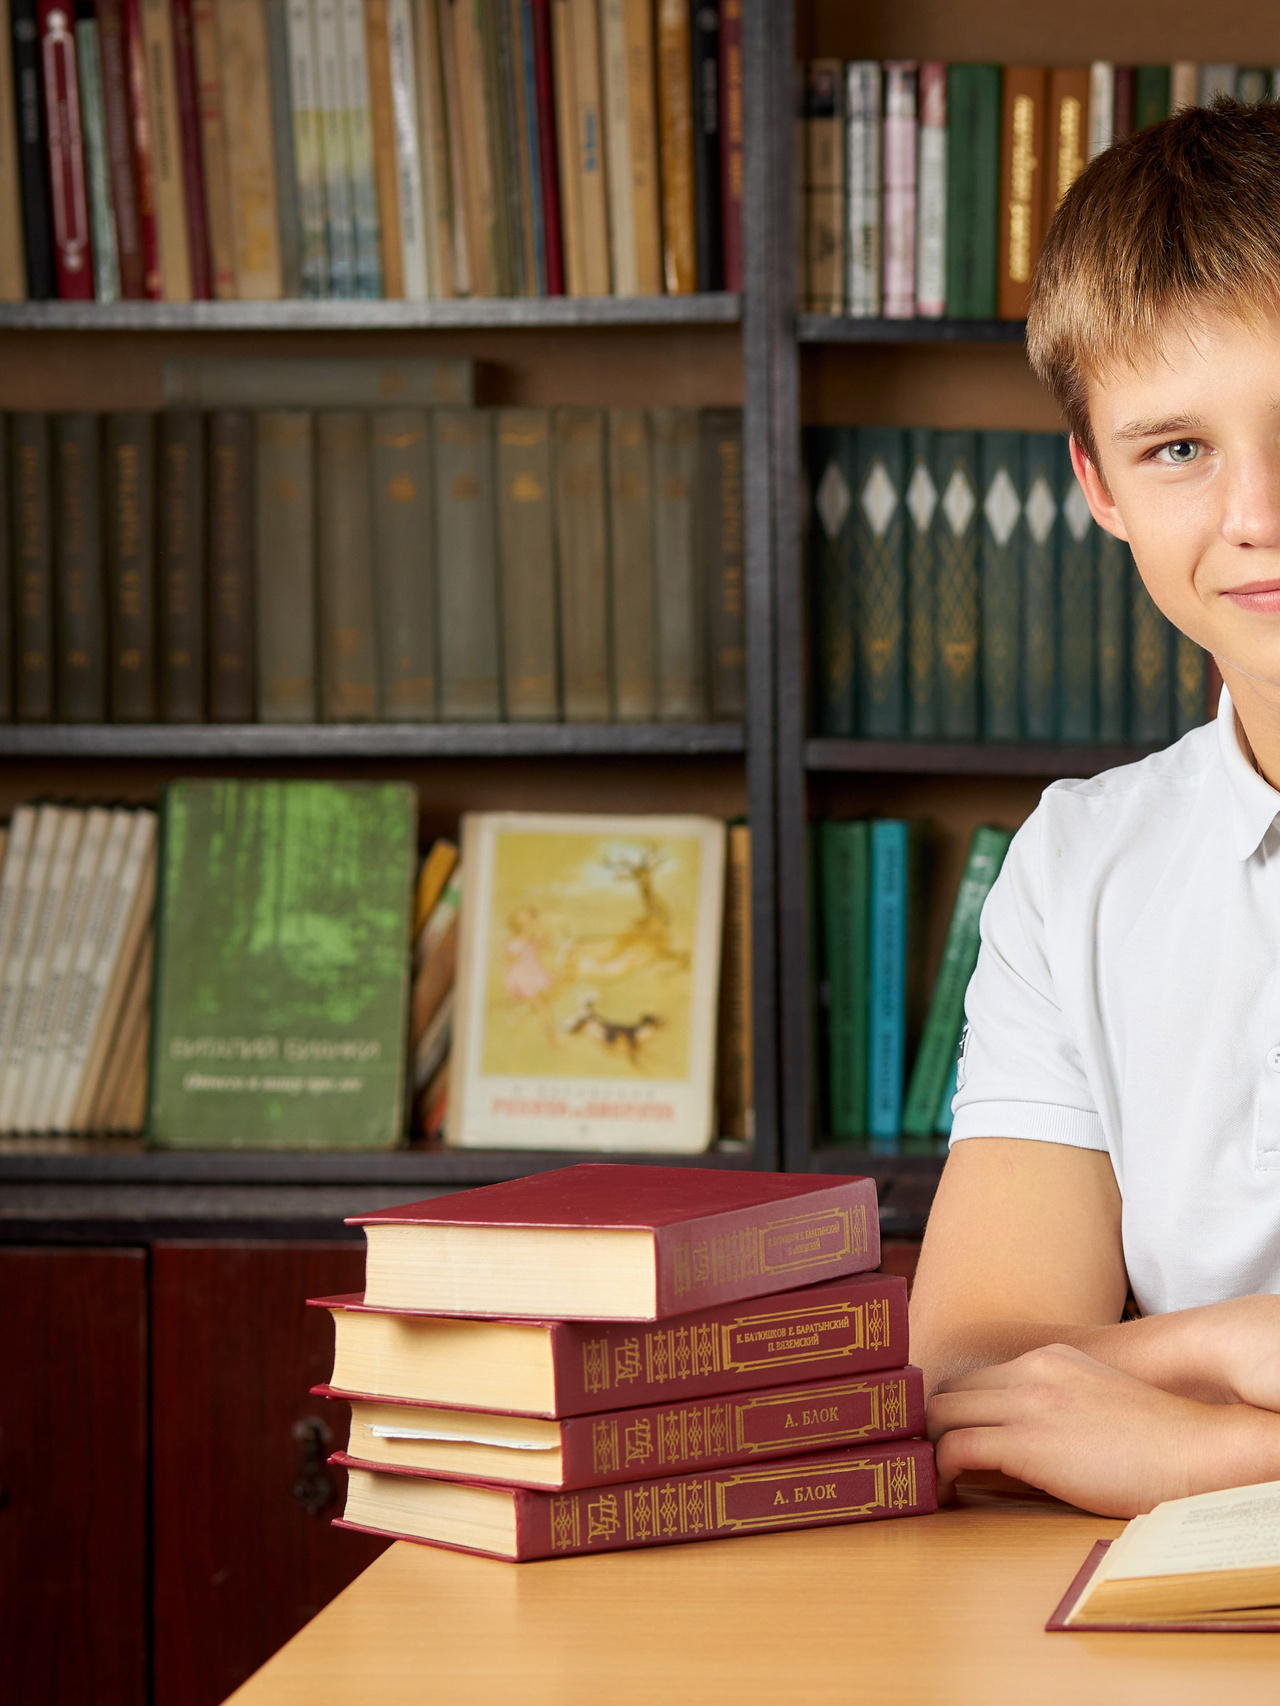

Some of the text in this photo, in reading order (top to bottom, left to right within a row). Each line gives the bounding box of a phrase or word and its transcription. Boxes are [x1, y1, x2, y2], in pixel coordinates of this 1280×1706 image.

[744, 1328, 786, 1343] БАТЮШКОВ
[788, 1326, 795, 1336] Е.
[796, 1316, 849, 1334] БАРАТЫНСКИЙ
[768, 1333, 819, 1352] П. ВЯЗЕМСКИЙ
[784, 1406, 839, 1428] А. БЛОК
[773, 1483, 837, 1505] А. БЛОК
